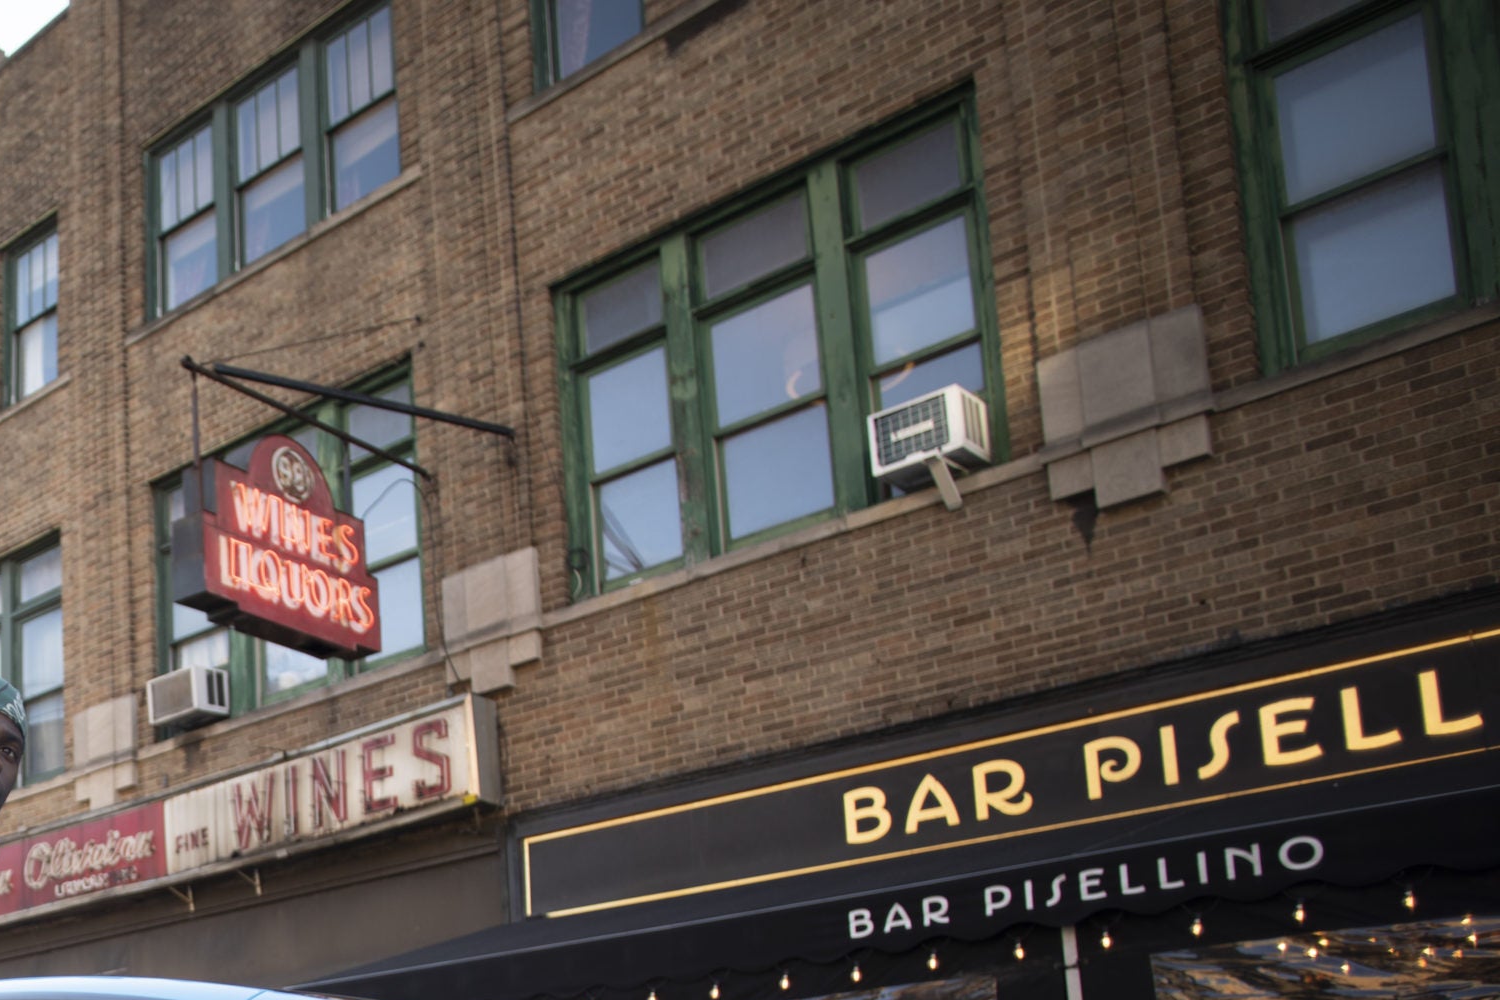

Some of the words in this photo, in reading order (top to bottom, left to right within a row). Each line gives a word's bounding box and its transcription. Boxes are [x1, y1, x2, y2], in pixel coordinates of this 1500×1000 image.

[229, 480, 361, 574] WINES
[218, 534, 376, 635] LIQUORS
[174, 827, 210, 855] FINE
[231, 718, 452, 851] WINES
[842, 759, 1033, 845] BAR
[1083, 670, 1484, 801] PISELL
[848, 895, 950, 939] BAR
[984, 836, 1324, 917] PISELLINO
